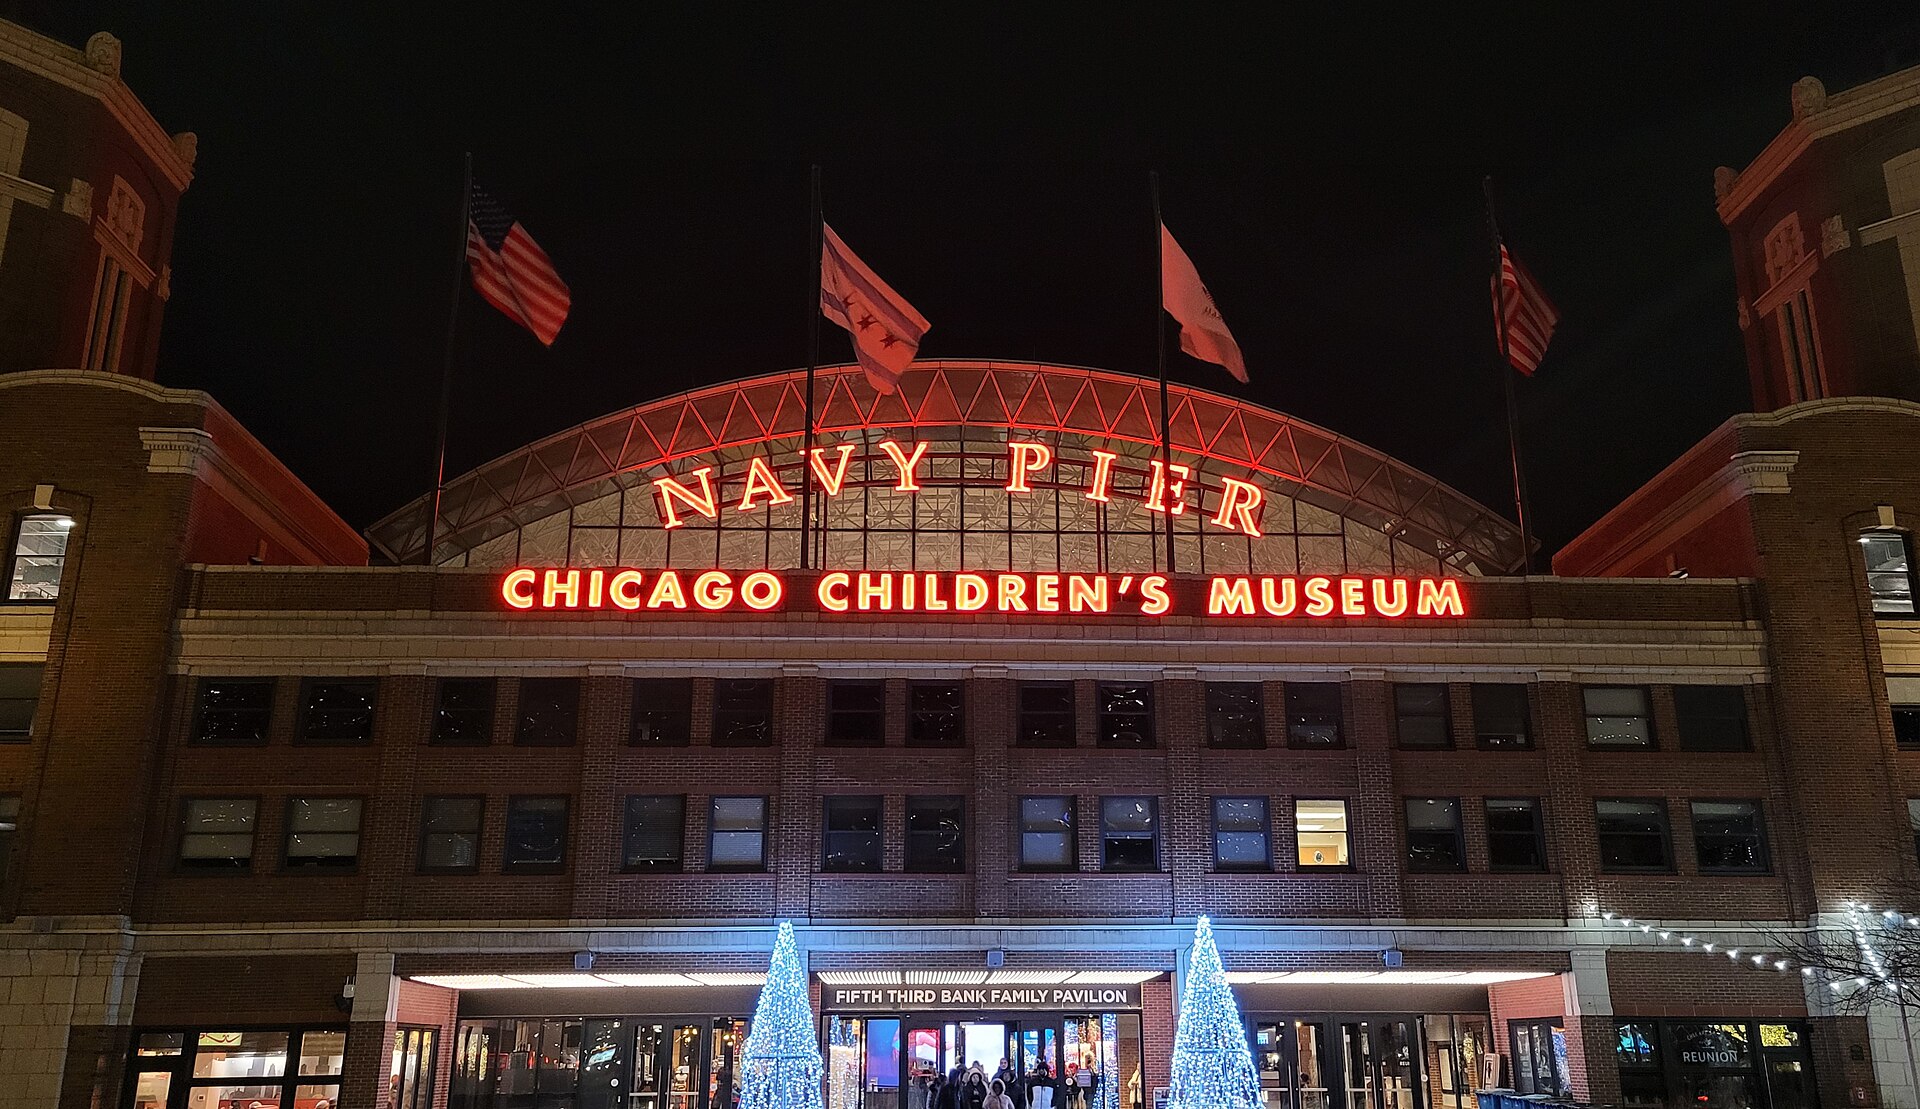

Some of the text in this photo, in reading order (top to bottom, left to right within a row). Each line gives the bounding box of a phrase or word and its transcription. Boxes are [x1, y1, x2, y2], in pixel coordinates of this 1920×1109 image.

[653, 441, 1264, 538] NAVY PIER
[501, 568, 1466, 617] CHICAGO CHILDREN'S MUSEUM
[835, 989, 1127, 1003] FIFTH THIRD BANK FAMILY PAVILION
[1682, 1051, 1739, 1063] REUNION
